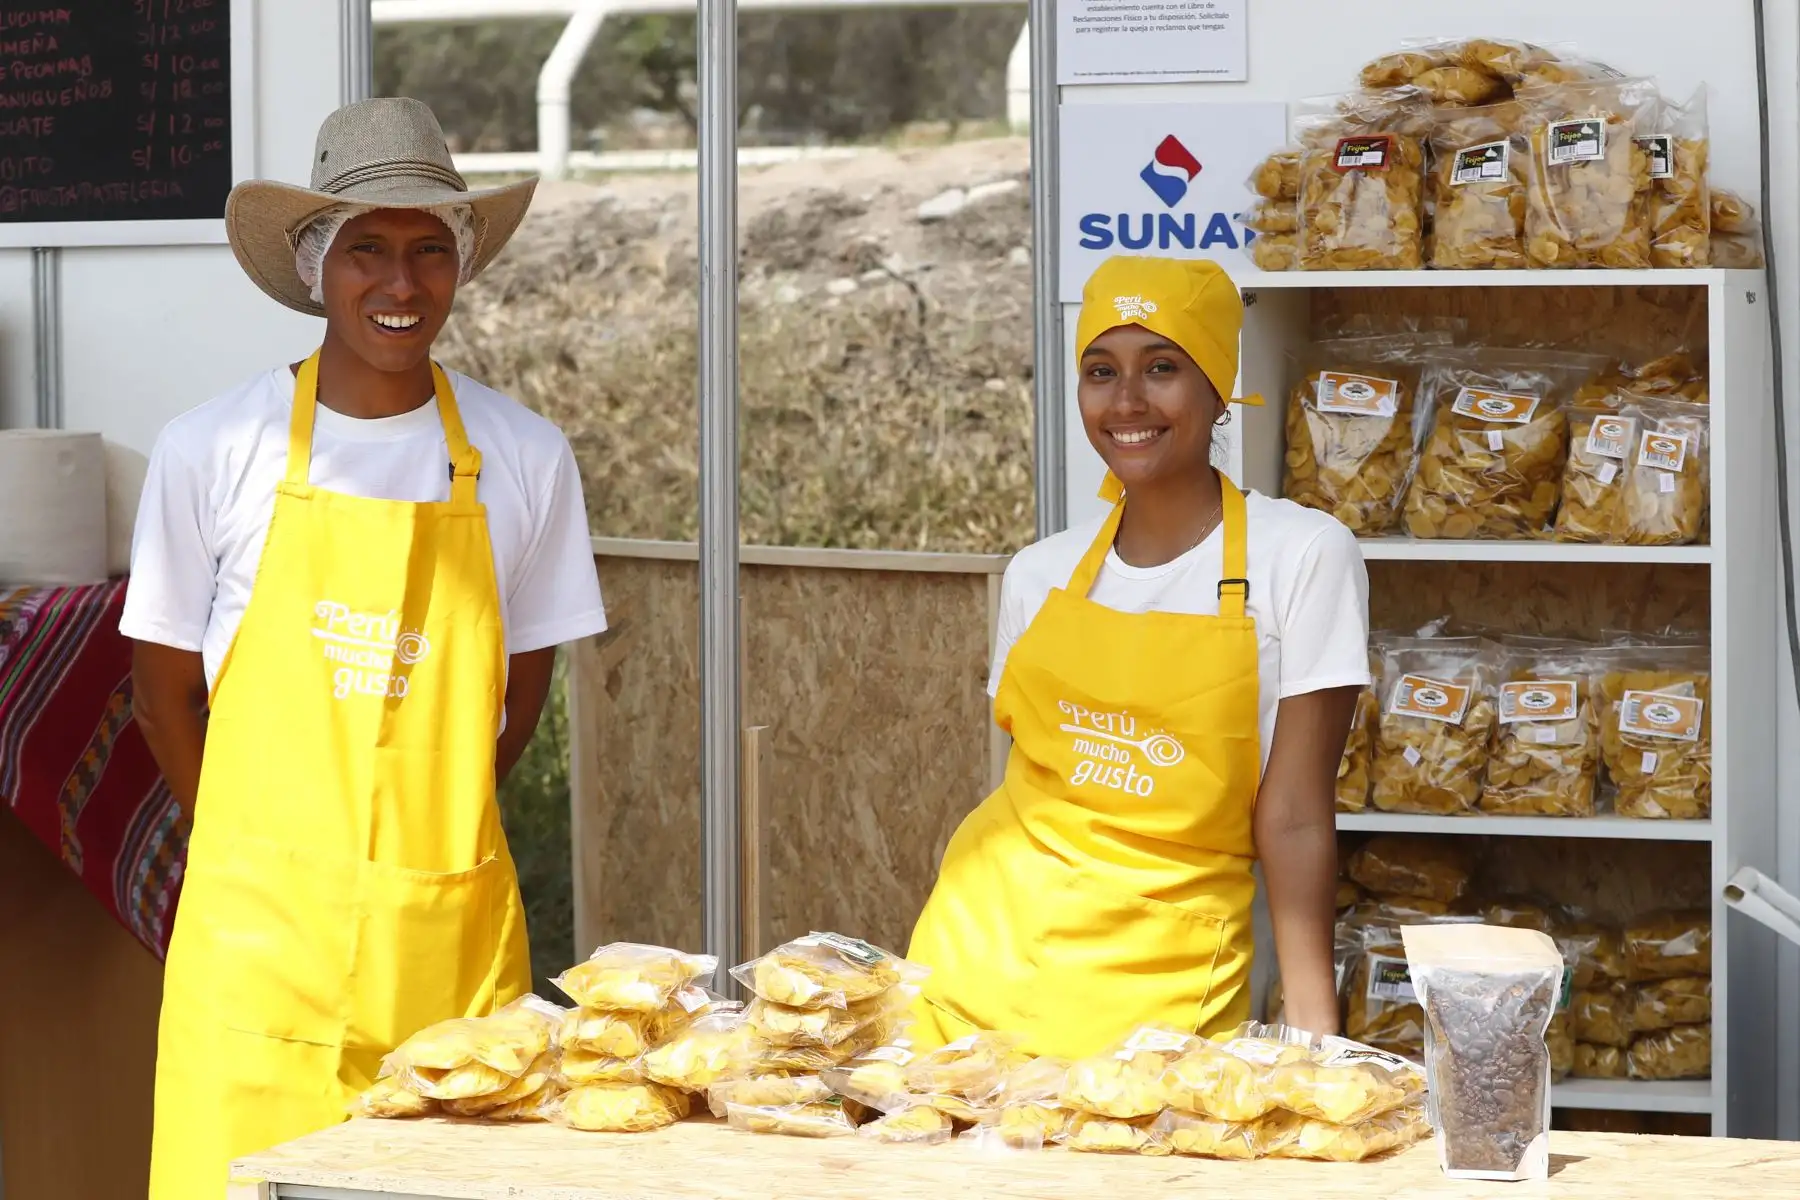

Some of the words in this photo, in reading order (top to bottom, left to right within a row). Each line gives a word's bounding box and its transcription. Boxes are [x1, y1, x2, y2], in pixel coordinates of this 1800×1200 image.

[315, 600, 398, 640] Perú
[324, 643, 392, 670] mucho
[333, 667, 409, 700] gusto
[1059, 699, 1135, 736] Perú
[1072, 738, 1130, 764] mucho
[1070, 760, 1154, 796] gusto
